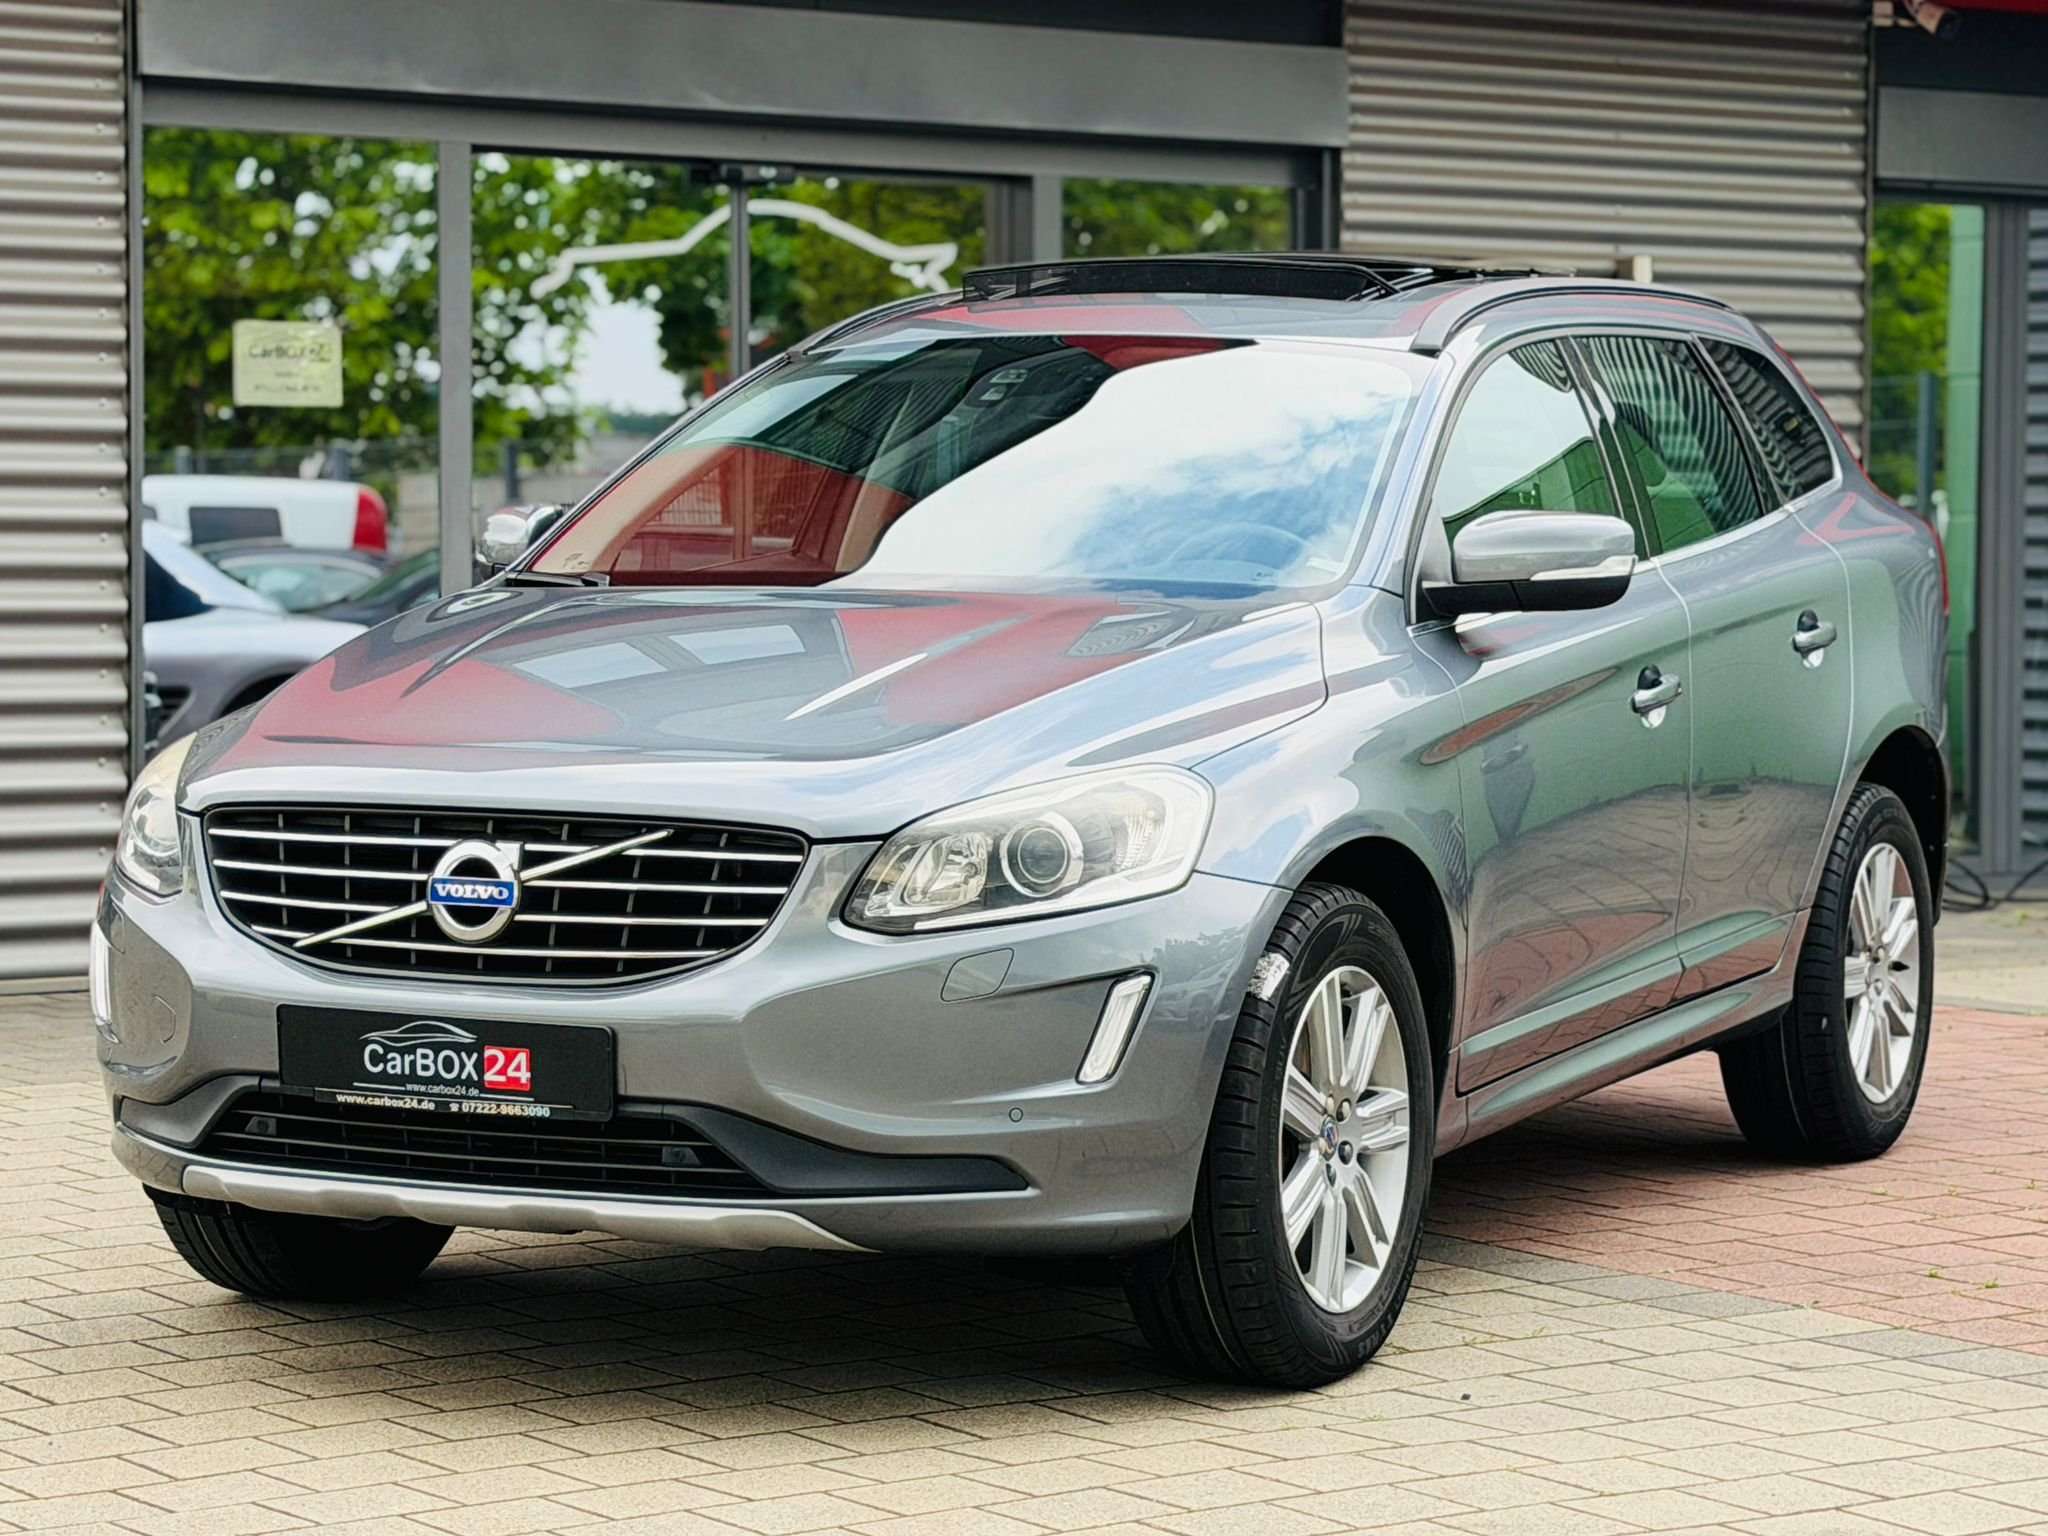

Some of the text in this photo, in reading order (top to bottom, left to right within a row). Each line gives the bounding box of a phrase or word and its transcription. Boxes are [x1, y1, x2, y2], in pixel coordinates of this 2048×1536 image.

[433, 883, 509, 900] VOLVO
[405, 1083, 480, 1097] www.carbox24.de
[335, 1094, 436, 1110] www.carbox24.de
